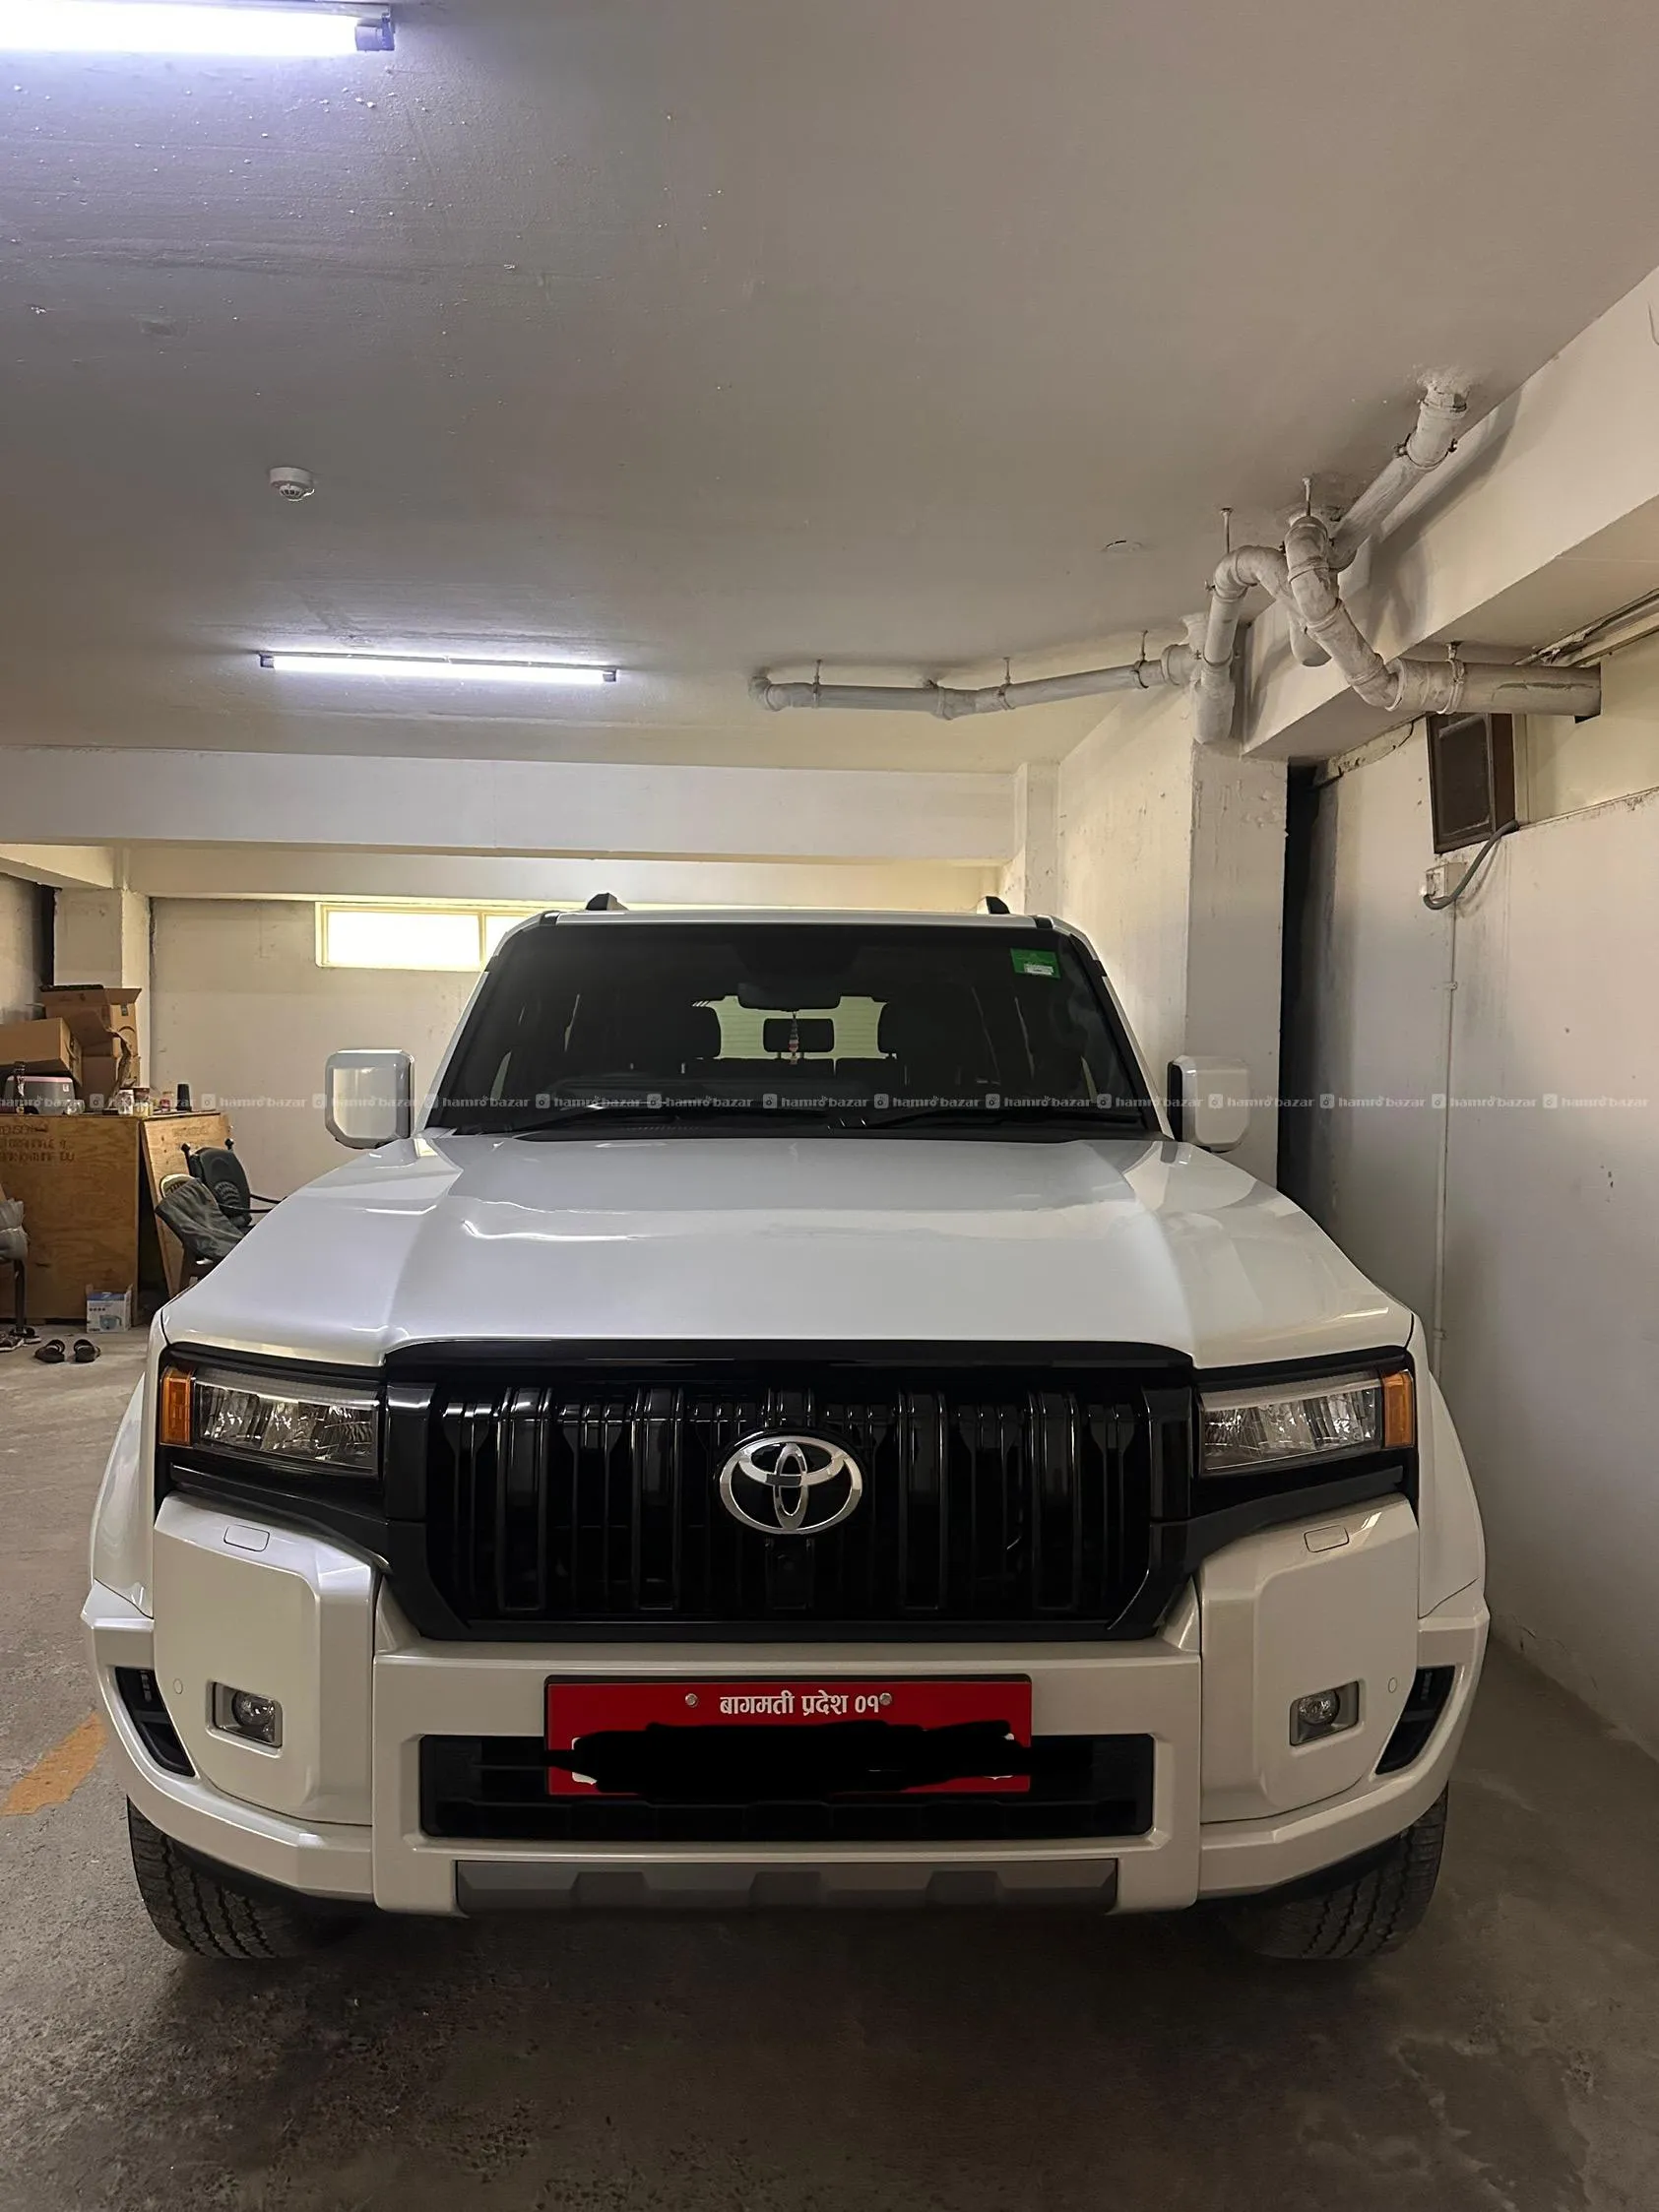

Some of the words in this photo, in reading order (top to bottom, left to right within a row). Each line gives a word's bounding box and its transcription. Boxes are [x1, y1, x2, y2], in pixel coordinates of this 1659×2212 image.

[720, 1689, 795, 1715] बागमती
[801, 1689, 849, 1716] प्रदेश
[855, 1695, 879, 1714] ०१
